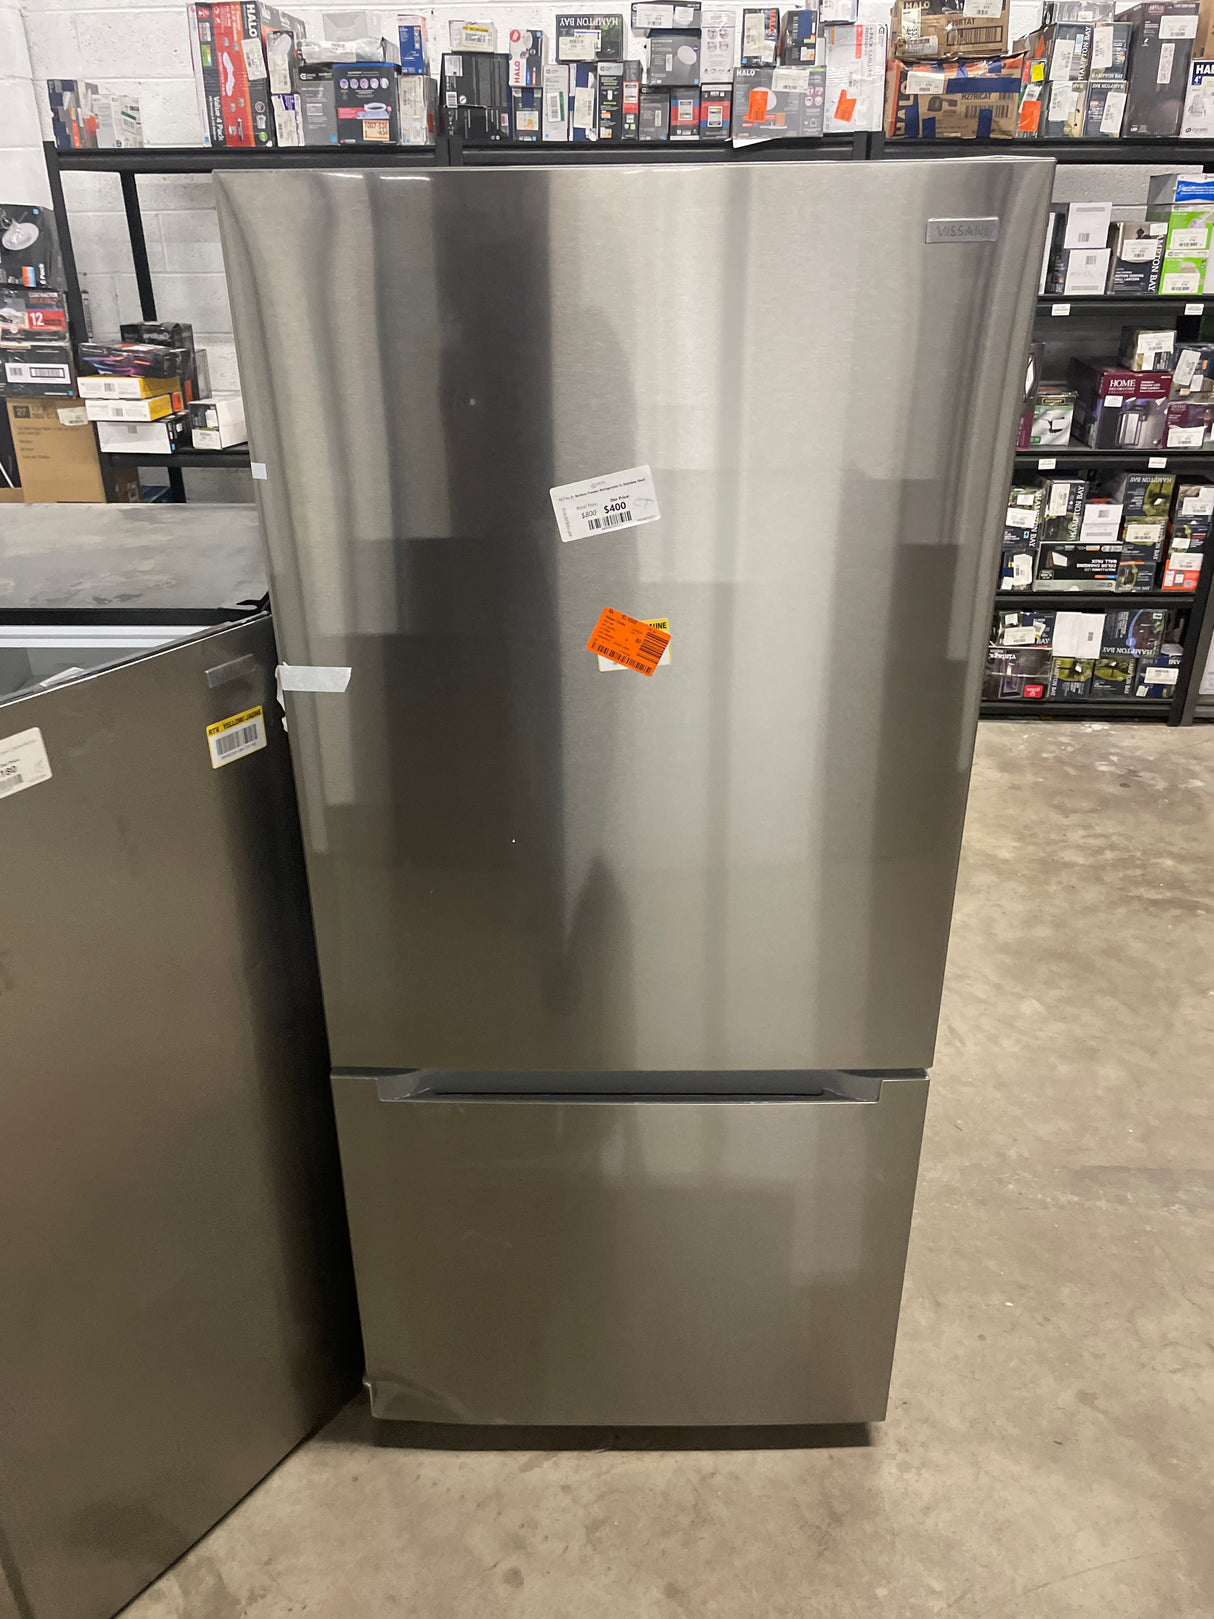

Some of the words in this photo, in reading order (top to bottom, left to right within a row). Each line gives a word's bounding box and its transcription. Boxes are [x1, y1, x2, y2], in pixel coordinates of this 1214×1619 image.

[905, 1, 930, 10] HALO
[246, 4, 258, 37] HALO
[559, 17, 575, 27] BAY
[576, 17, 619, 27] HAMPTON
[1078, 40, 1090, 80] HAMPTON
[1084, 26, 1092, 39] BAY
[514, 60, 522, 84] HALO
[735, 69, 756, 77] HALO
[1196, 64, 1214, 75] HAL
[213, 96, 222, 116] Value
[216, 124, 224, 142] Pack
[936, 224, 988, 237] VISSANI
[1153, 234, 1166, 272] AMPTON
[38, 263, 46, 280] Pack
[1148, 273, 1158, 292] BAY
[30, 312, 44, 325] 12
[1109, 379, 1136, 387] HOME
[1140, 476, 1172, 484] HAMPTON
[581, 509, 597, 519] $800
[603, 501, 627, 514] $400
[1069, 501, 1082, 541] HAMPTON
[1076, 485, 1085, 500] BAY
[1028, 533, 1037, 548] BAY
[208, 726, 220, 736] RTV
